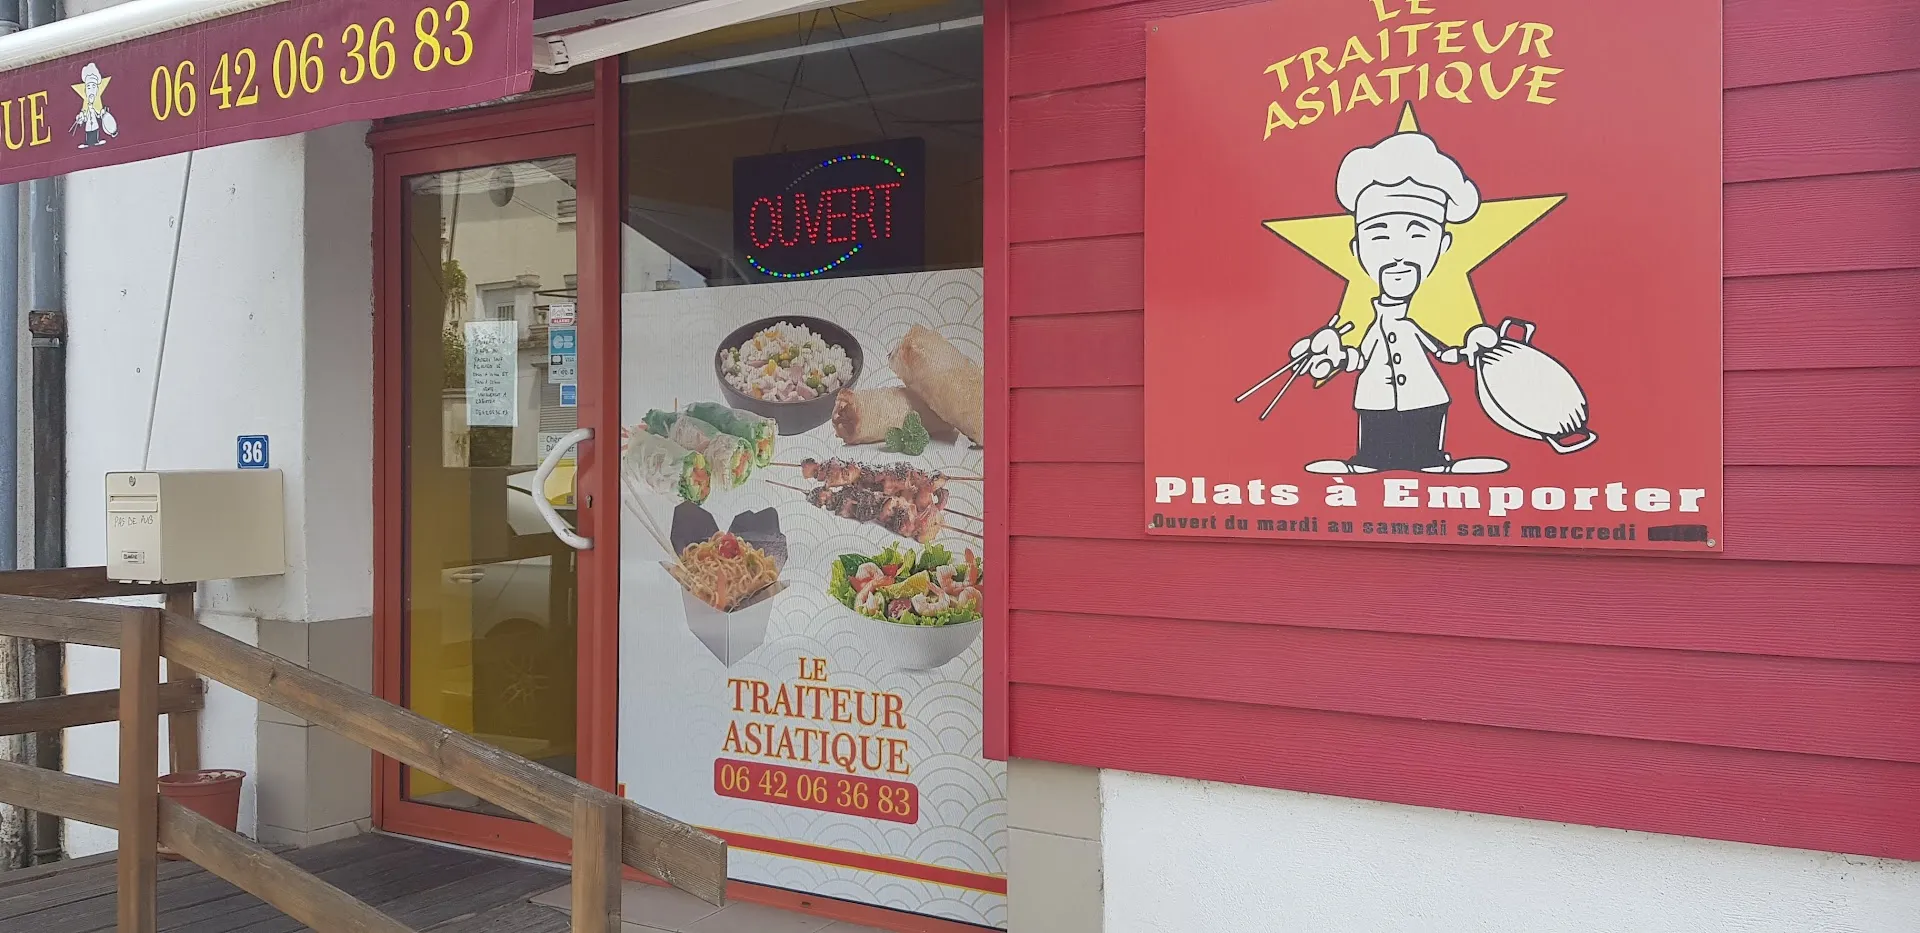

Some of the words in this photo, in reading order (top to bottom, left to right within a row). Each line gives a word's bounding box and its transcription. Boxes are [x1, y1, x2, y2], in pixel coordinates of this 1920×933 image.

[0, 90, 51, 150] UE
[150, 60, 196, 121] 06
[209, 47, 259, 110] 42
[272, 32, 324, 100] 06
[340, 17, 396, 85] 36
[413, 0, 474, 73] 83
[1263, 20, 1555, 93] TRAITEUR
[1263, 61, 1565, 142] ASIATIQUE
[750, 182, 901, 249] OUVERT
[242, 440, 263, 463] 36
[128, 516, 137, 526] DE
[1155, 476, 1300, 506] Plats
[1323, 476, 1358, 507] à
[1383, 478, 1706, 518] Emporter
[1153, 513, 1217, 530] Ouvert
[1225, 514, 1249, 531] du
[1257, 516, 1318, 533] mardi
[1327, 519, 1353, 533] au
[1362, 519, 1447, 536] samedi
[1456, 520, 1512, 538] sauf
[1520, 523, 1636, 541] mercredi
[798, 656, 828, 683] LE
[727, 678, 908, 731] TRAITEUR
[722, 719, 911, 776] ASIATIQUE
[721, 764, 751, 793] 06
[758, 769, 788, 799] 42
[797, 774, 829, 804] 06
[836, 779, 869, 810] 36
[878, 785, 911, 816] 83
